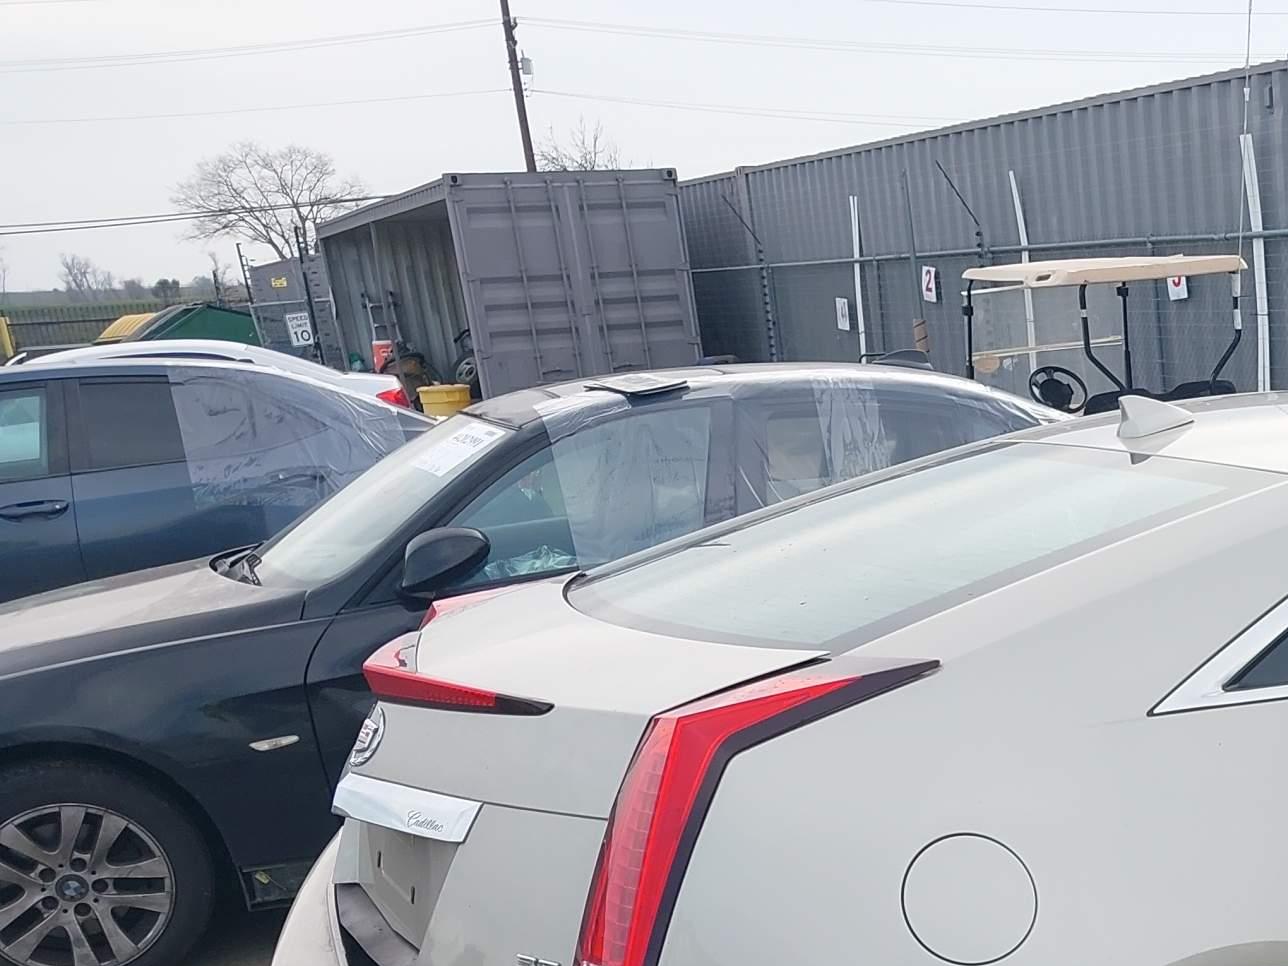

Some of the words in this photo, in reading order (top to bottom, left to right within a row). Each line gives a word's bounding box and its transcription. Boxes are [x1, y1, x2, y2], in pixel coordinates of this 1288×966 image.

[925, 269, 933, 292] 2
[294, 330, 311, 342] 10
[407, 810, 444, 833] Cadillac
